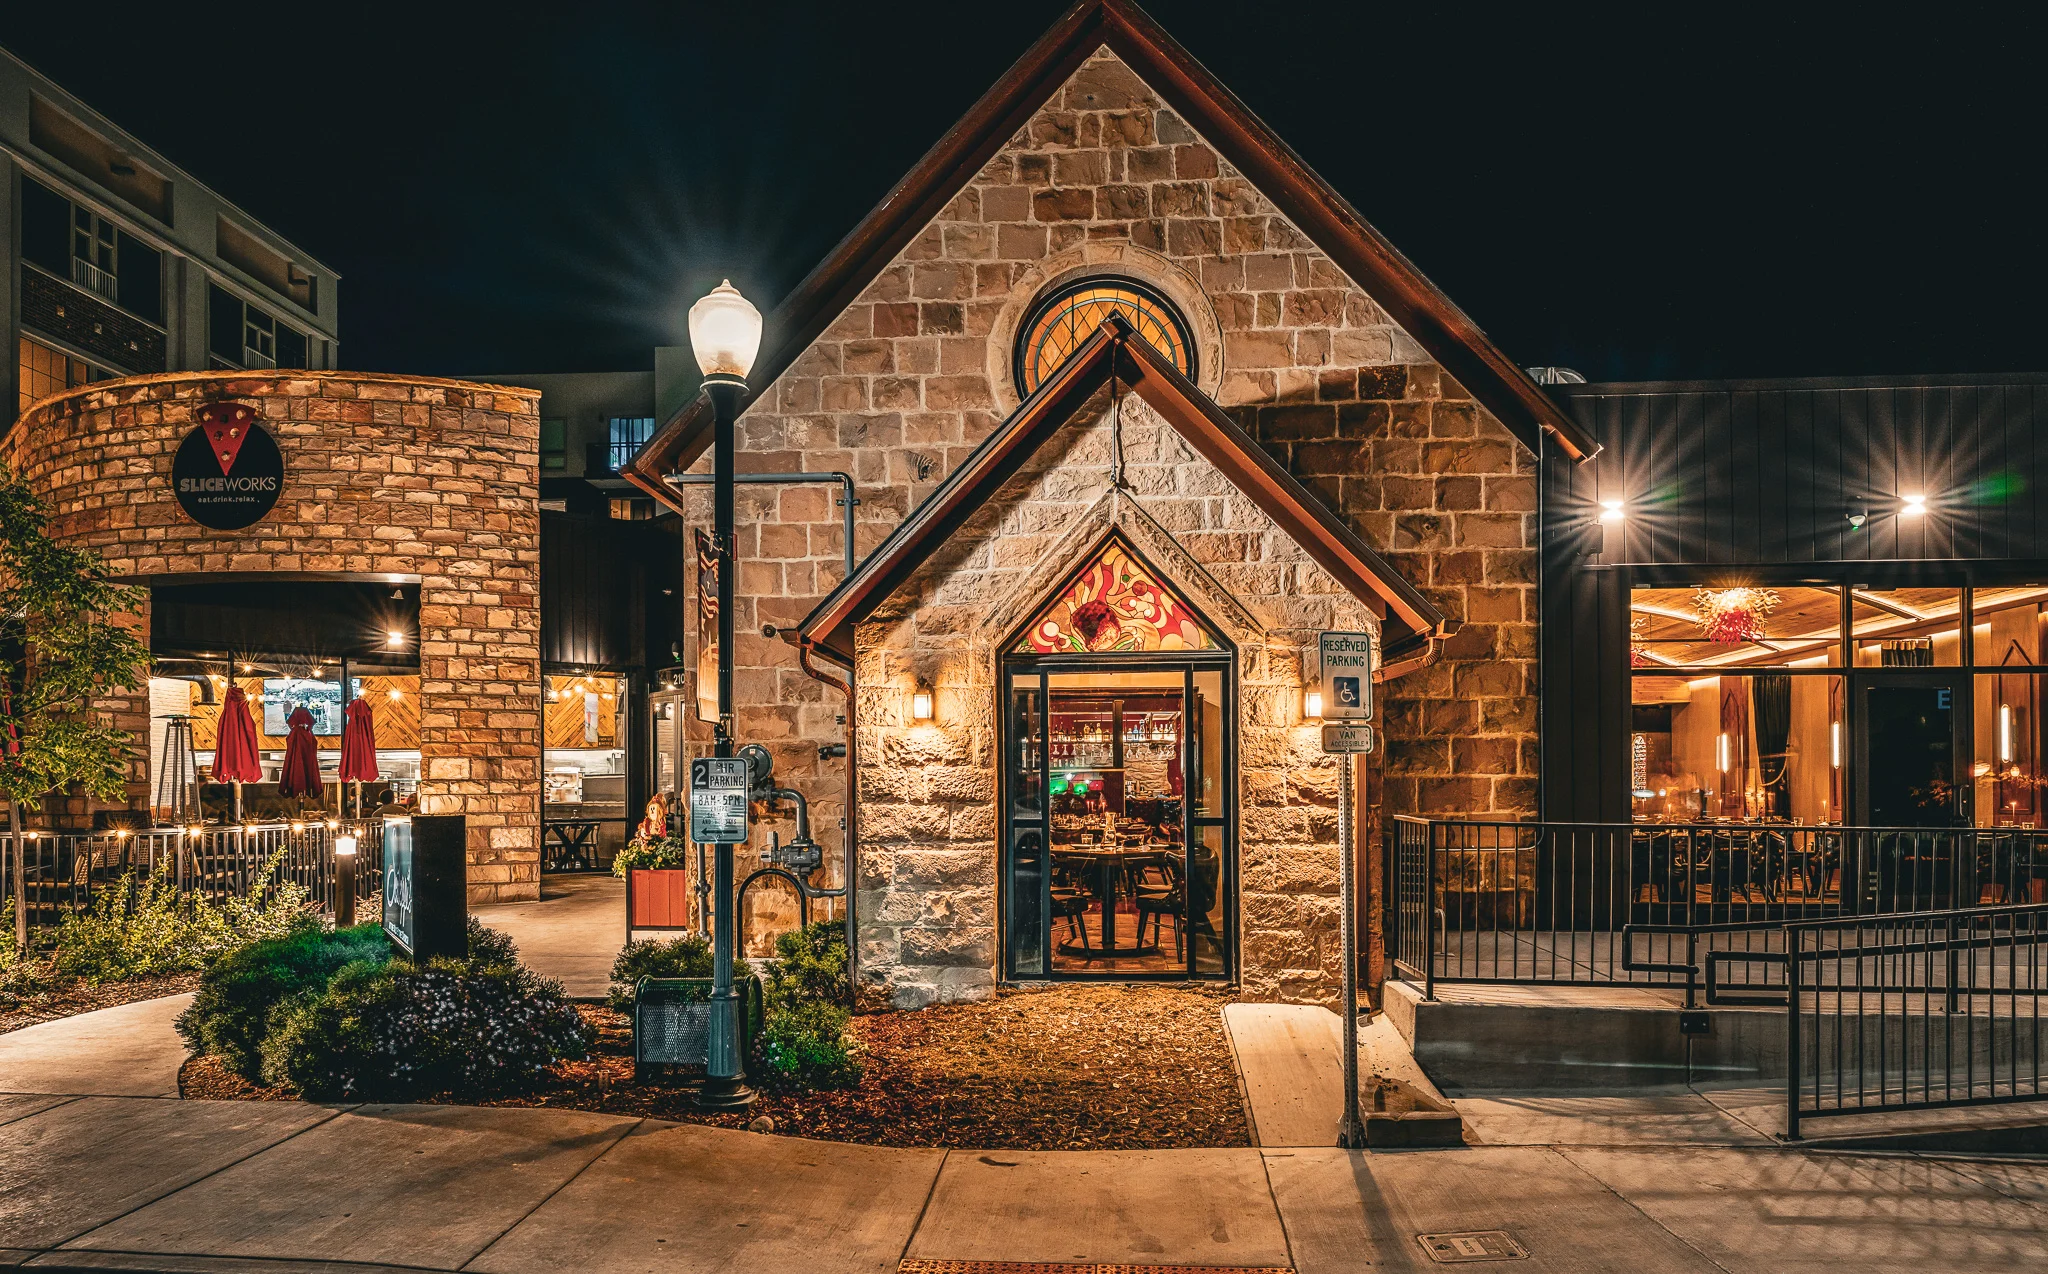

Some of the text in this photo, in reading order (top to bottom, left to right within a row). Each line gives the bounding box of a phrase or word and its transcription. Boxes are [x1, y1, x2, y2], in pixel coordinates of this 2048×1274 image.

[180, 477, 276, 492] SLICEWORKS
[1323, 640, 1367, 652] RESERVED
[1326, 655, 1365, 667] PARKING
[1339, 731, 1355, 739] VAN
[694, 764, 706, 785] 2
[710, 776, 744, 787] PARKING
